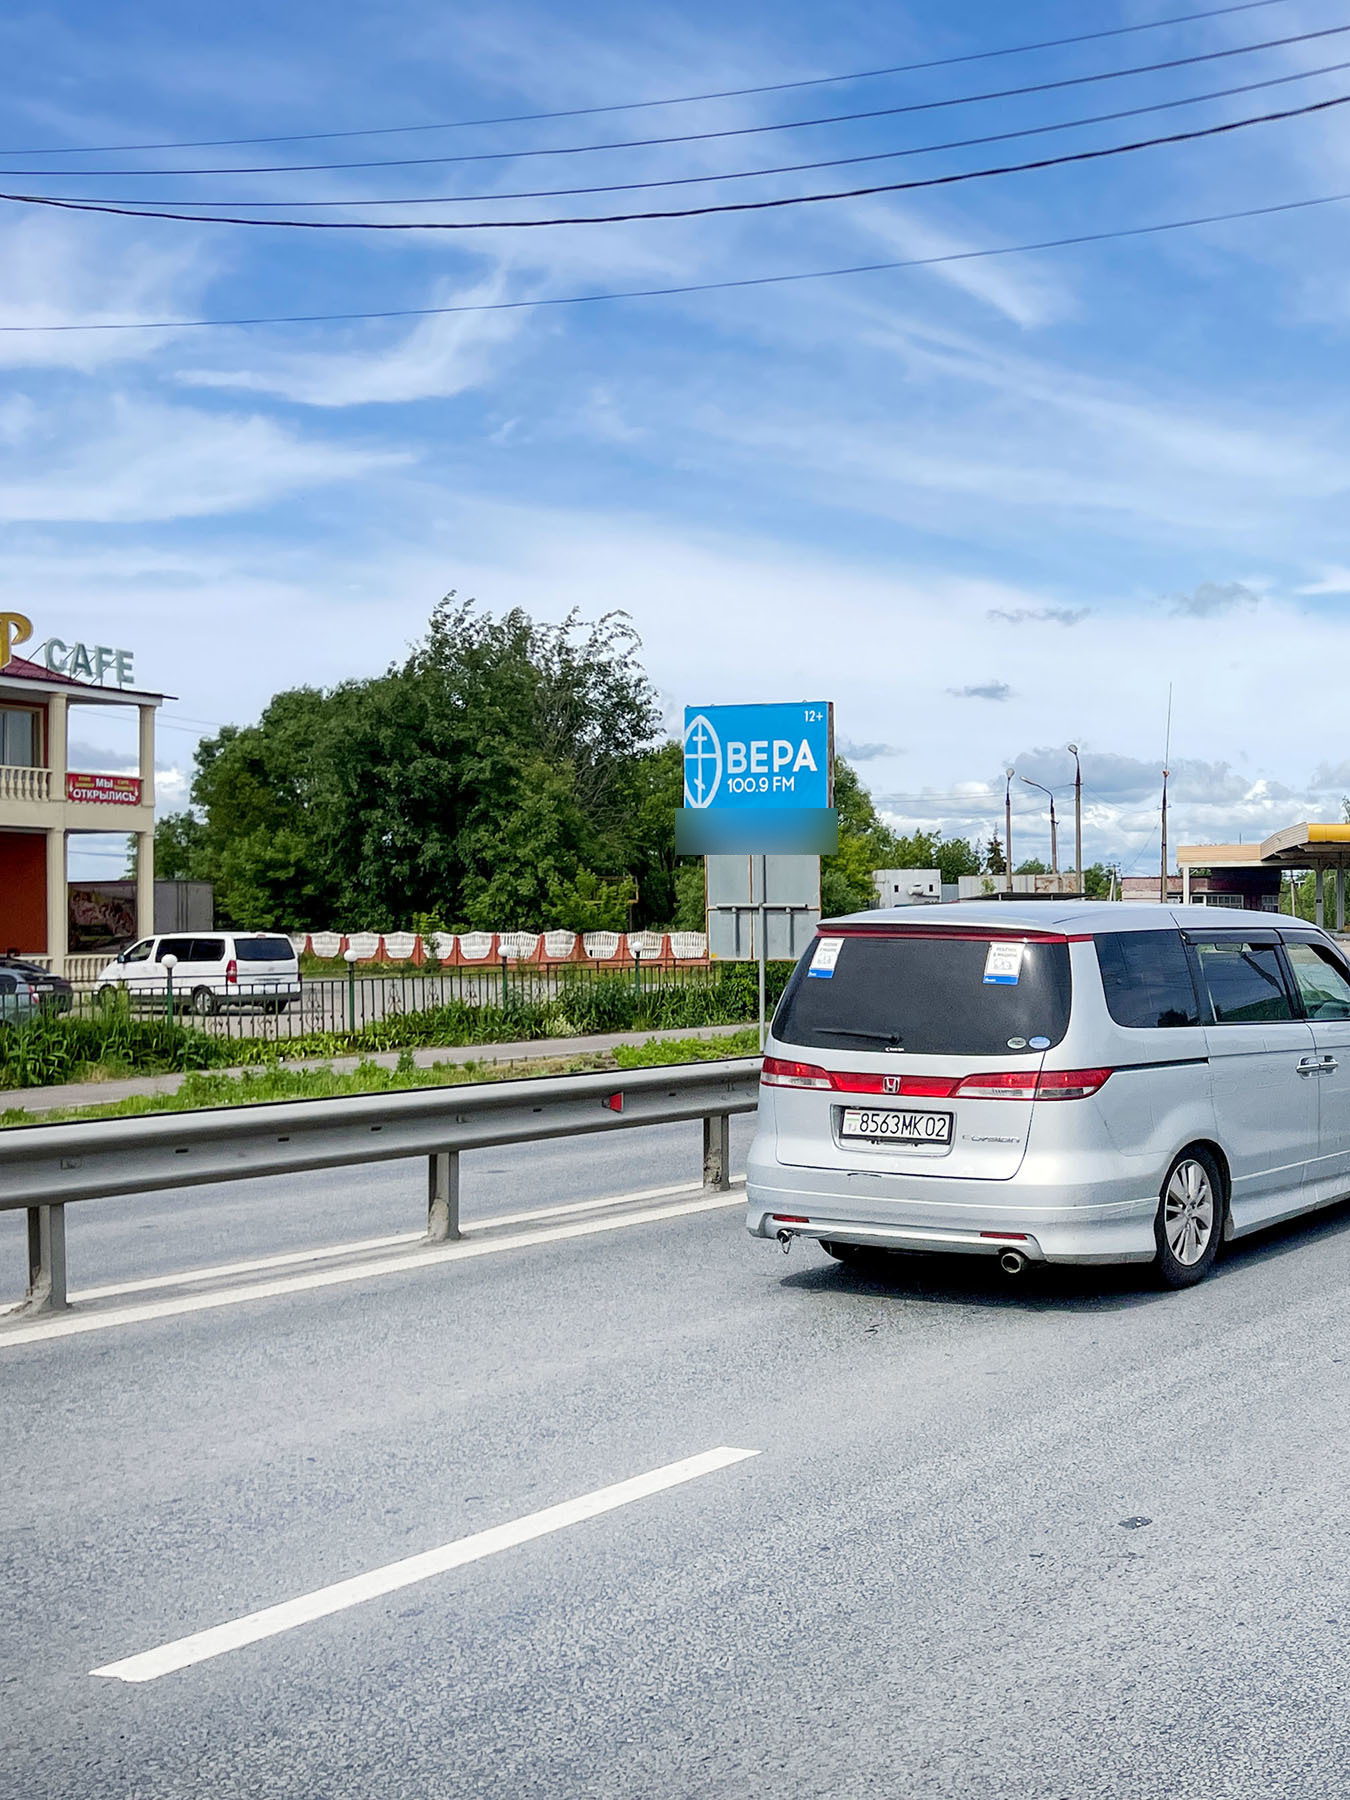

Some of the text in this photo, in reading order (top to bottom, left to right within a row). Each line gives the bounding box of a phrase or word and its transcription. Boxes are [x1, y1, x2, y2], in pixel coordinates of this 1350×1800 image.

[44, 637, 134, 684] CAFE
[804, 710, 824, 723] 12+
[726, 738, 819, 774] ВЕРА
[95, 777, 114, 789] МЫ
[727, 776, 795, 794] 100.9 FM
[72, 788, 137, 802] ОТКРЫЛИСЬ
